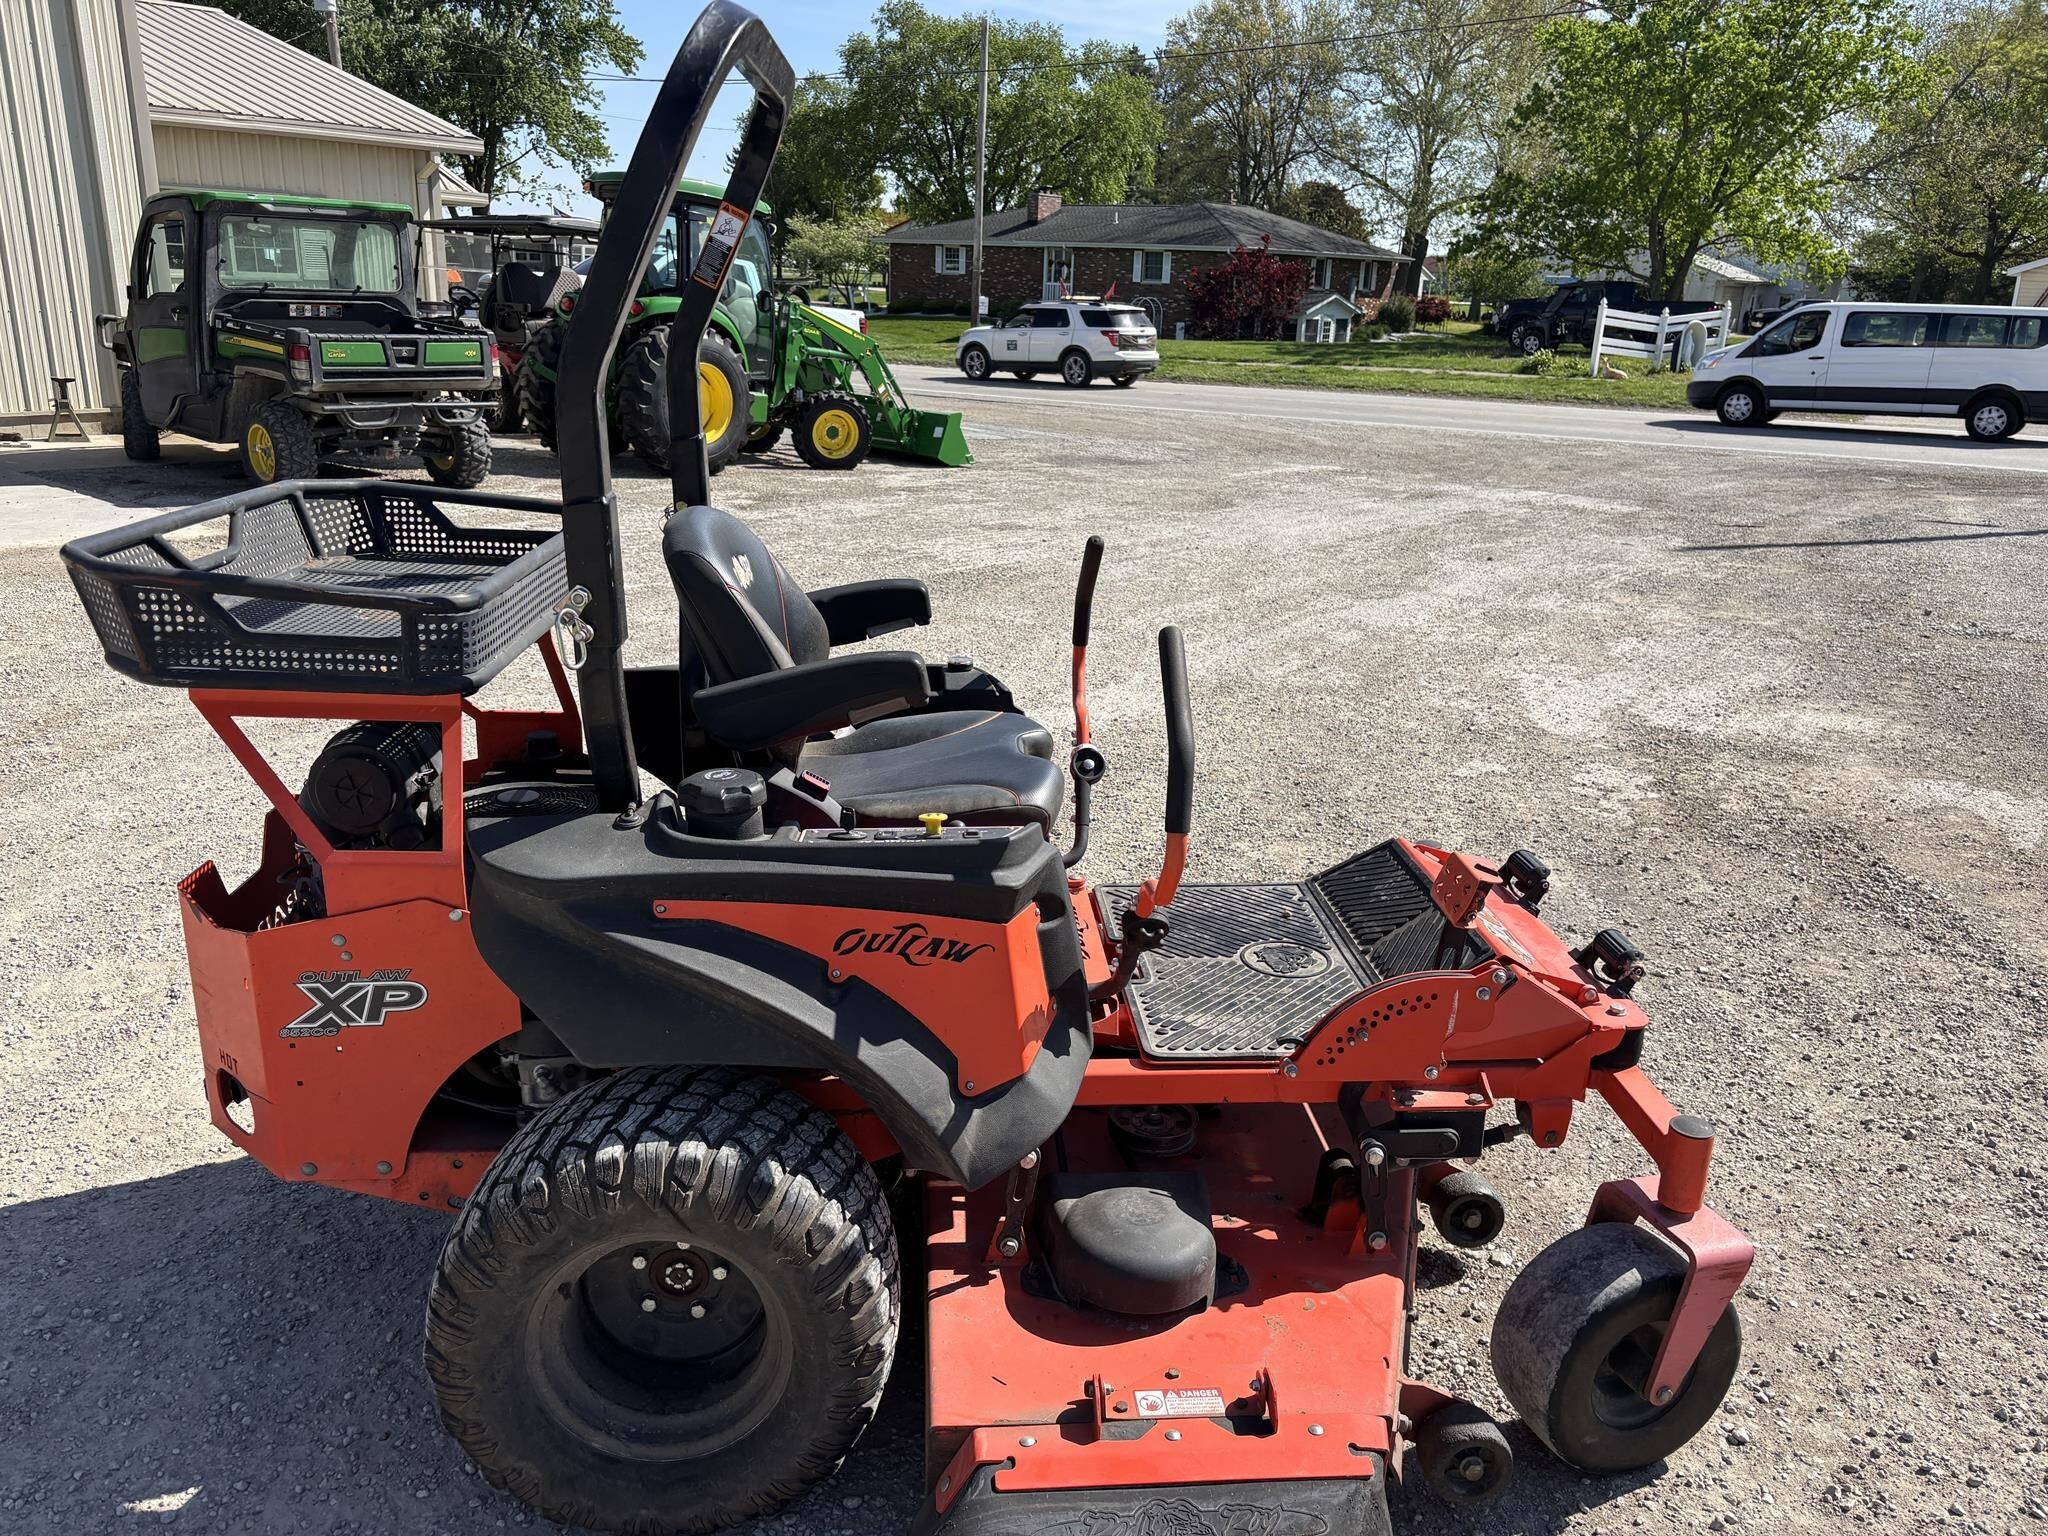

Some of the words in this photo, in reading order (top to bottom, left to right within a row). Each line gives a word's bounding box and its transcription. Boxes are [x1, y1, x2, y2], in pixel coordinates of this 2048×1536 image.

[833, 923, 995, 966] OUTLAW
[298, 969, 412, 982] OUTLAW
[284, 981, 428, 1028] XP
[218, 1047, 239, 1075] HOT
[1180, 1389, 1219, 1398] DANGER
